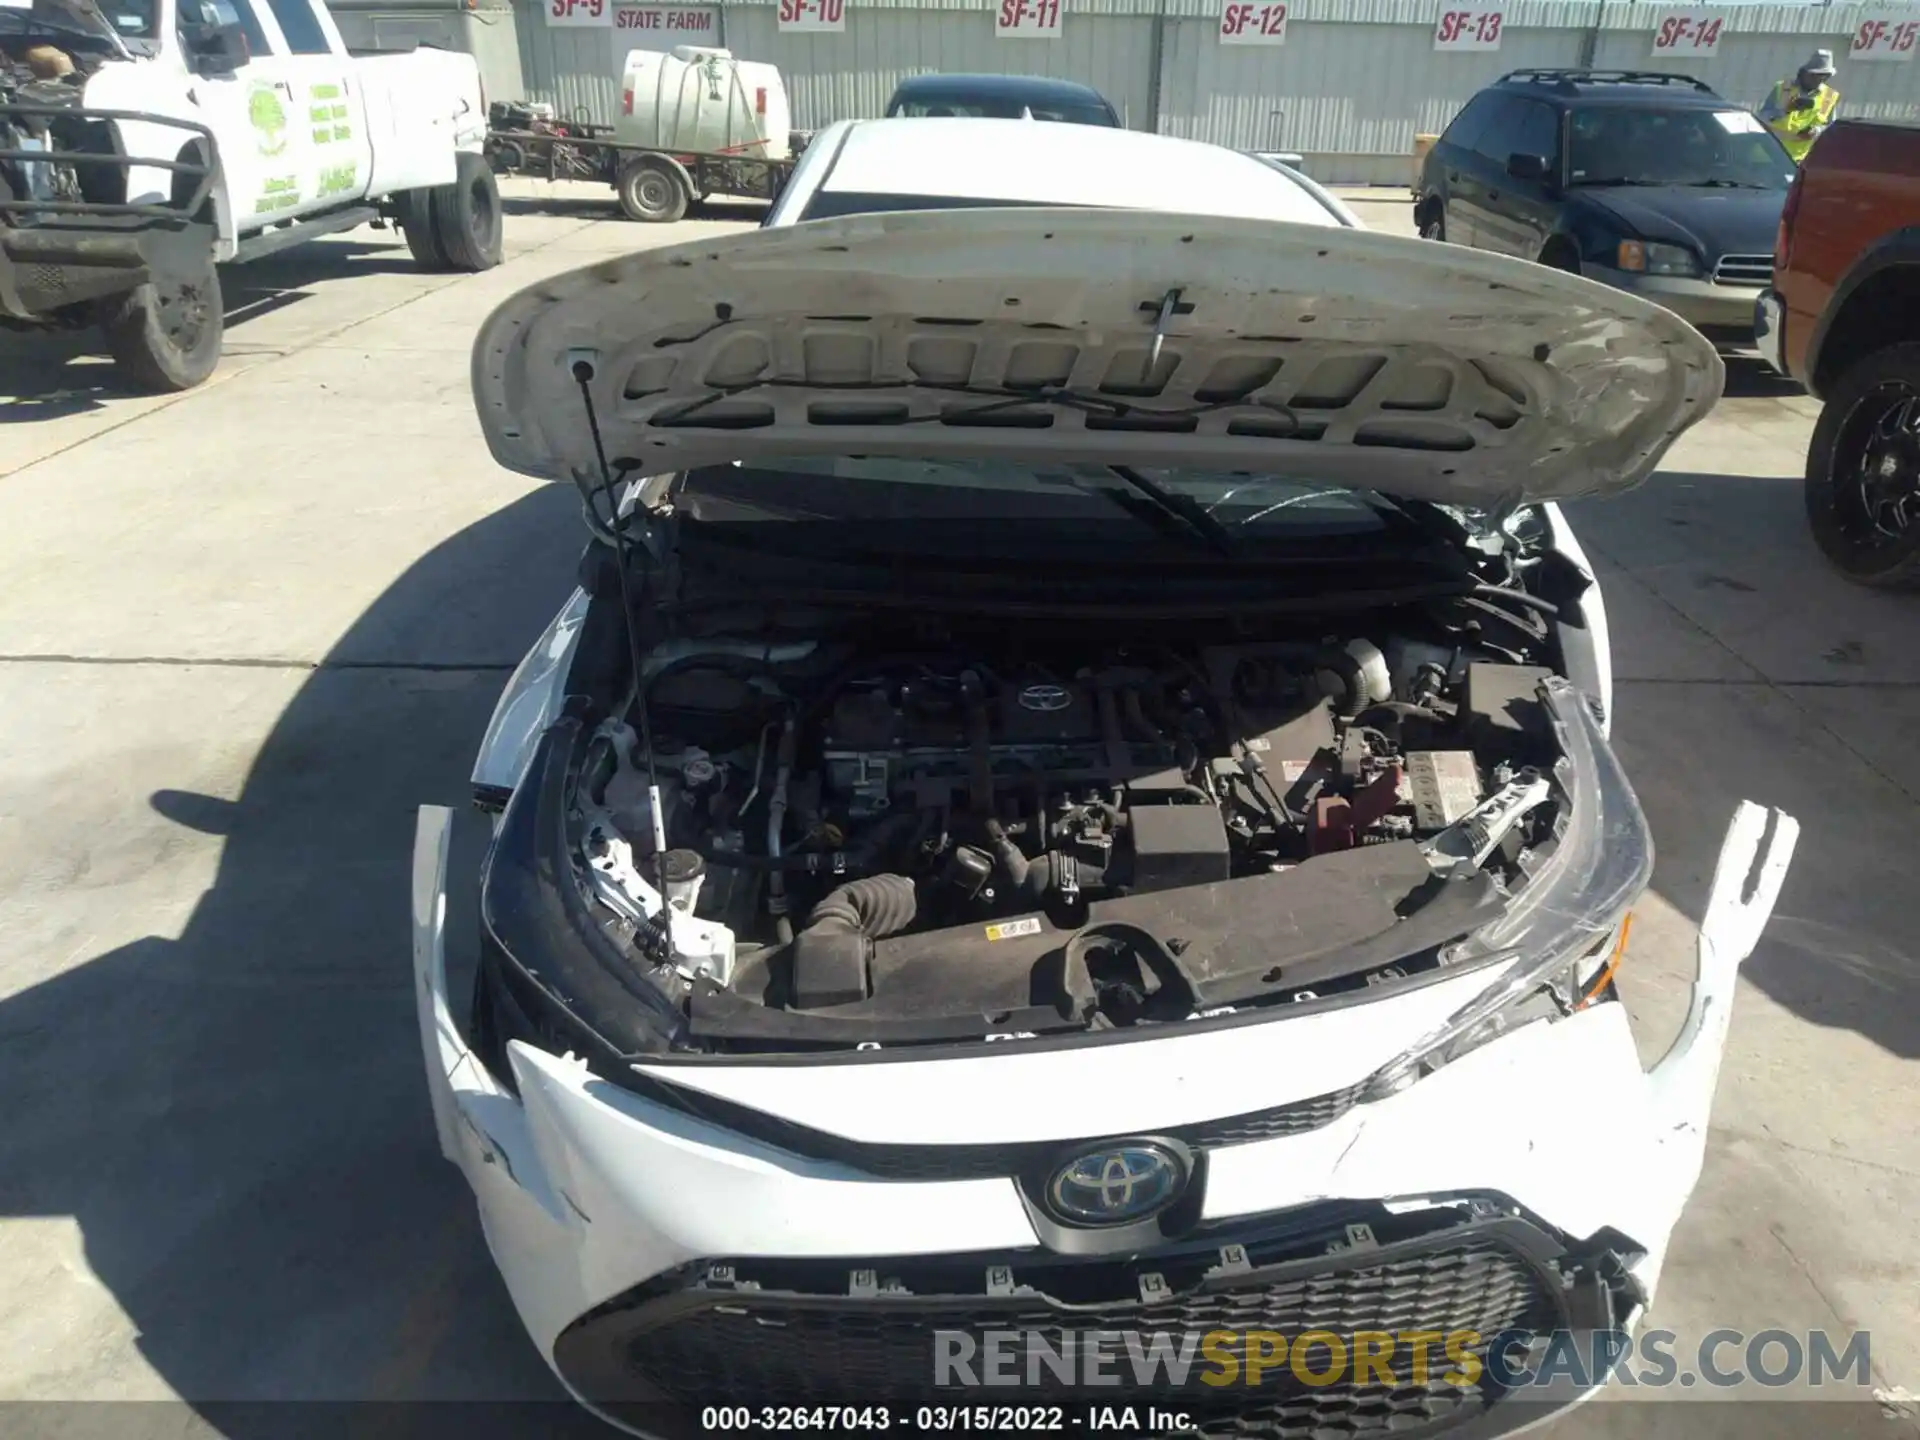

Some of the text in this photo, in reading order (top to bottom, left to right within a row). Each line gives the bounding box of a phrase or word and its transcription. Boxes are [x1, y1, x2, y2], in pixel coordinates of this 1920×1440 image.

[617, 10, 711, 31] STATE FARM
[779, 0, 842, 22] SF-10
[999, 0, 1057, 28] SF-11
[1222, 4, 1286, 35] SF-12
[1438, 11, 1502, 42] SF-13
[1657, 17, 1722, 47] SF-14
[1854, 20, 1920, 50] SF-15
